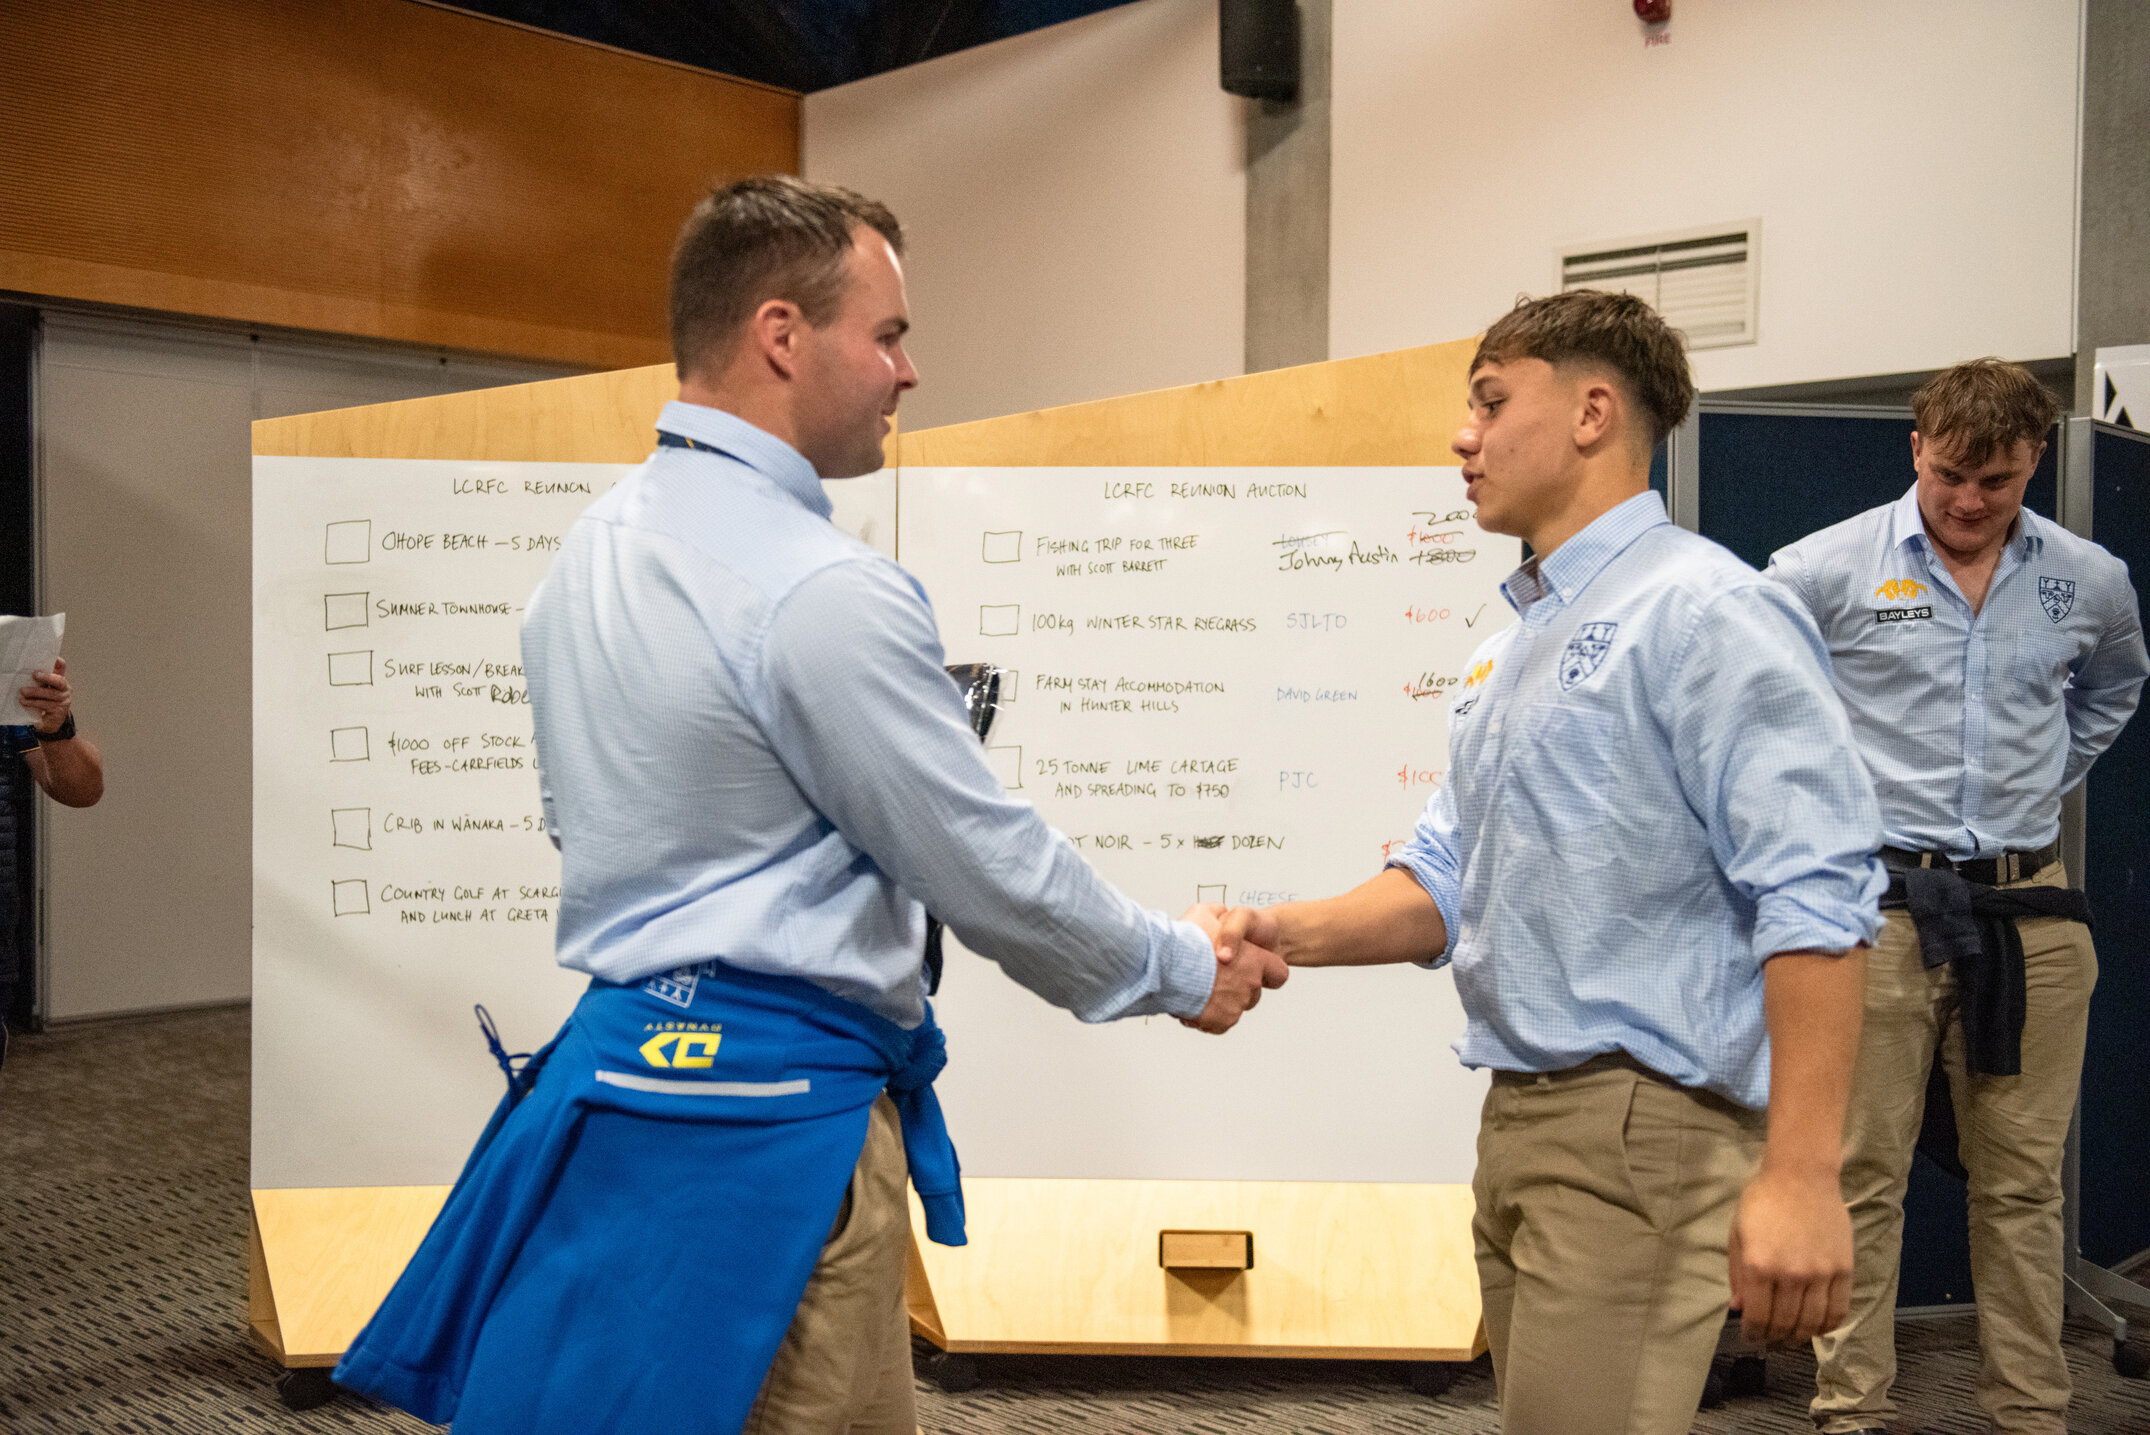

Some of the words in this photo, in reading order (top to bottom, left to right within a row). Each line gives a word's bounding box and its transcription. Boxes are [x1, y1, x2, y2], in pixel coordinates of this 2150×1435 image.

[453, 478, 509, 495] LCRFC
[524, 481, 592, 494] REUNION
[1104, 482, 1155, 499] LCRFC
[1171, 482, 1236, 499] REUNION
[1246, 483, 1307, 498] AUCTION
[382, 531, 435, 551] OHOPE
[443, 533, 488, 550] BEACH
[526, 534, 561, 551] DAYS
[1036, 536, 1089, 556] FISHING
[1095, 537, 1123, 551] TRIP
[1129, 538, 1154, 551] FOR
[1157, 534, 1200, 550] THREE
[1348, 539, 1399, 565] Austin
[1056, 562, 1082, 577] WITH
[1088, 561, 1116, 575] SCOTT
[1122, 559, 1168, 573] BARRETT
[376, 599, 438, 619] SUMNER
[441, 601, 512, 616] TOWNHOUSE
[1879, 609, 1930, 622] BAYLEYS
[1032, 612, 1074, 636] 100kg
[1086, 615, 1145, 631] WINTER
[1148, 614, 1188, 631] STAR
[1194, 615, 1257, 632] RYEGRASS
[384, 658, 424, 678] SURF
[415, 684, 442, 698] WITH
[452, 682, 487, 697] SCOTT
[1036, 674, 1073, 692] FARM
[1077, 676, 1107, 692] STAY
[1276, 686, 1312, 703] DAVID
[1315, 689, 1358, 701] GREEN
[1059, 698, 1071, 713] IN
[1080, 697, 1133, 713] HUNTER
[1141, 699, 1179, 713] HILLS
[388, 731, 430, 757] $1000
[442, 736, 470, 753] OFF
[480, 733, 527, 749] STOCK
[1035, 758, 1058, 776] 25
[1062, 759, 1112, 775] TONNE
[1126, 759, 1163, 776] LIME
[1170, 757, 1239, 775] CARTAGE
[1055, 782, 1082, 799] AND
[1087, 782, 1157, 797] SPREADING
[1167, 784, 1186, 797] TO
[1196, 782, 1230, 799] $750
[383, 812, 423, 834] CRIB
[433, 818, 445, 830] IN
[1095, 835, 1134, 850] NOIR
[1160, 834, 1173, 849] 5
[1231, 835, 1286, 850] DOZEN
[380, 884, 446, 903] COUNTRY
[453, 886, 485, 901] GOLF
[492, 886, 510, 900] AT
[400, 911, 426, 923] AND
[432, 910, 472, 923] LUNCH
[480, 909, 495, 922] AT
[507, 907, 549, 922] GRETA
[643, 1021, 723, 1033] DYNASTY
